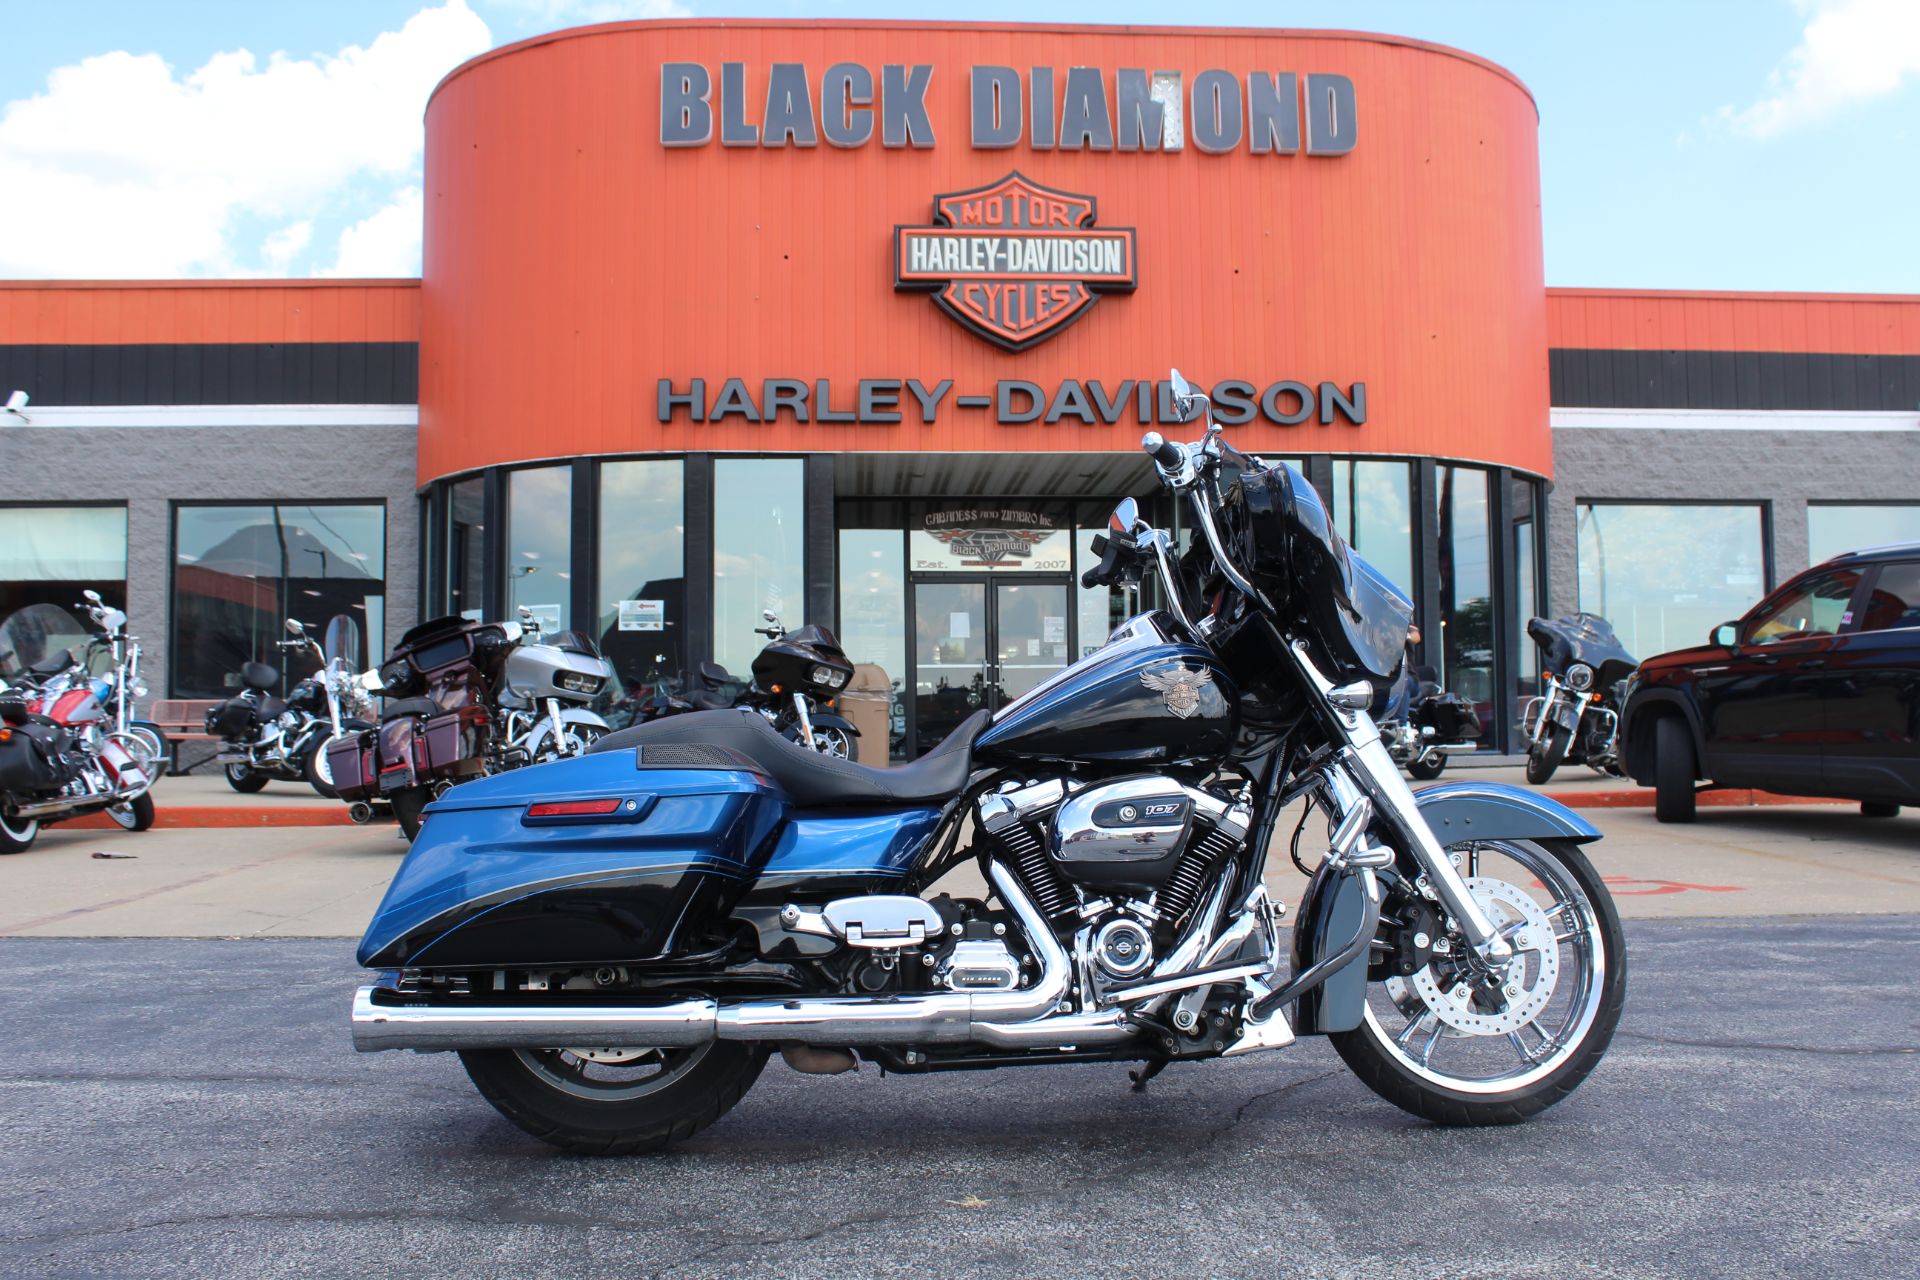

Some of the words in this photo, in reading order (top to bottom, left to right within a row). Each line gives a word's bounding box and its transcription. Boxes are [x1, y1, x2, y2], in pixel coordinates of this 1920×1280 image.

[659, 62, 936, 149] BLACK
[970, 64, 1359, 158] DIAMOND
[961, 187, 1072, 227] MOTOR
[911, 237, 1122, 274] HARLEY-DAVIDSON
[963, 283, 1071, 331] CYCLES
[916, 560, 948, 569] Est.
[1034, 560, 1067, 570] 2007
[1145, 803, 1180, 815] 107
